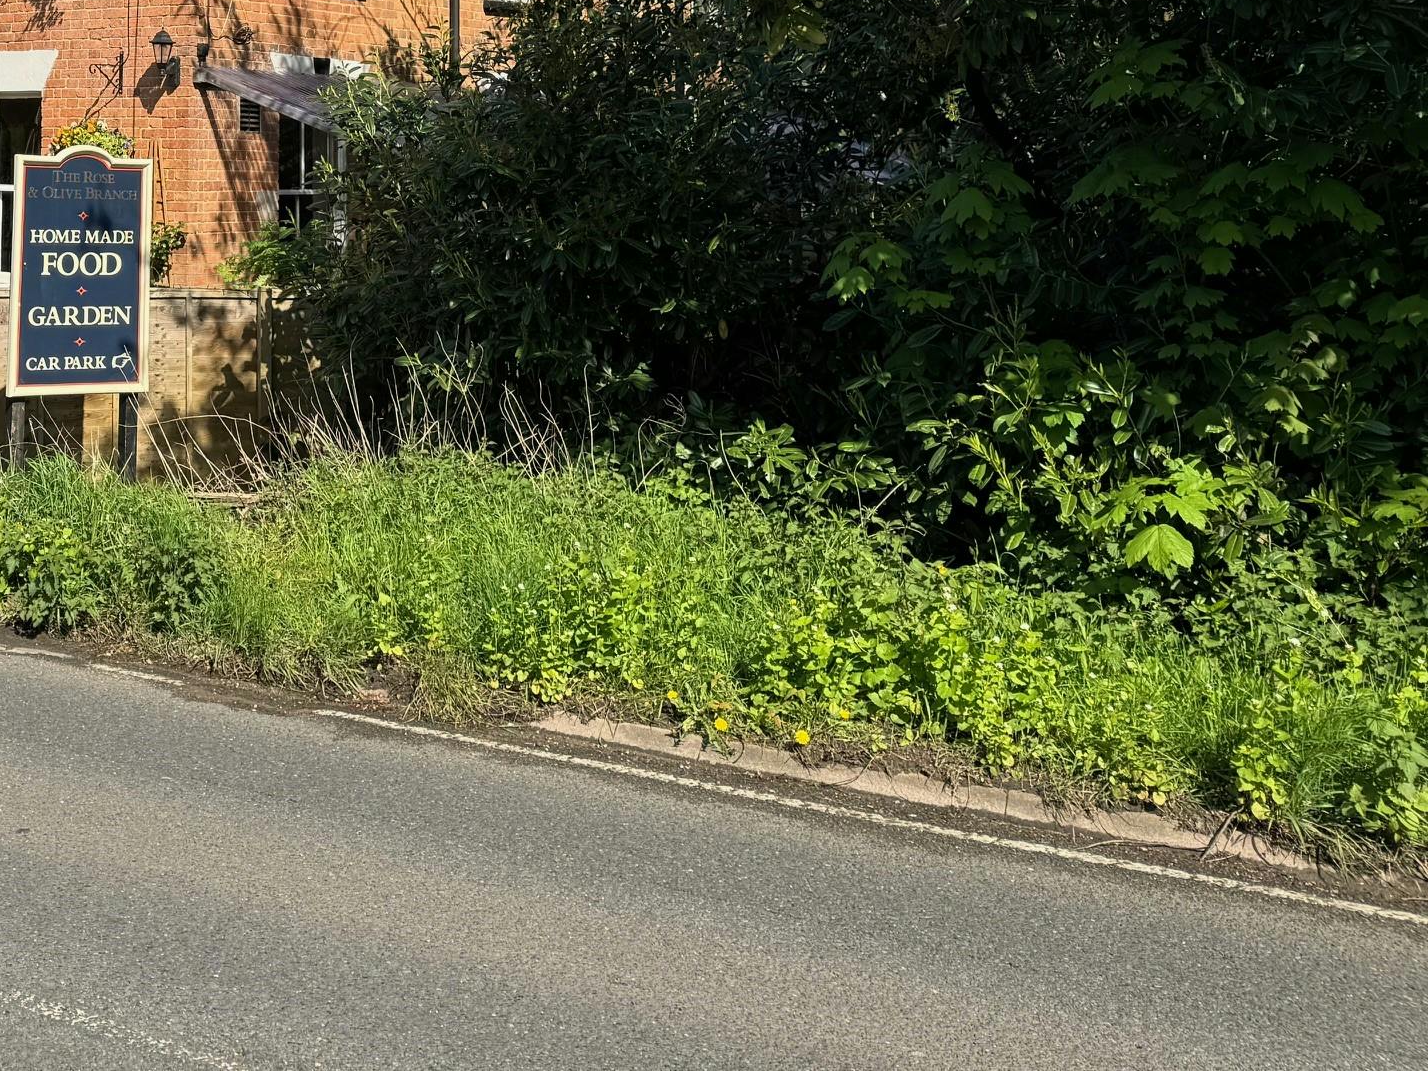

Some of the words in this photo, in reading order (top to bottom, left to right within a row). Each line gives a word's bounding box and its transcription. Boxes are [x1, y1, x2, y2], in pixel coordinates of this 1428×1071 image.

[52, 170, 81, 184] THE
[83, 171, 116, 184] ROSE
[27, 186, 39, 199] &
[42, 185, 82, 200] OLIVE
[85, 187, 138, 201] BRANCH
[29, 229, 81, 244] HOME
[84, 230, 134, 245] MADE
[40, 251, 122, 276] FOOD
[27, 305, 132, 327] GARDEN
[25, 357, 61, 371] CAR
[63, 355, 106, 370] PARK
